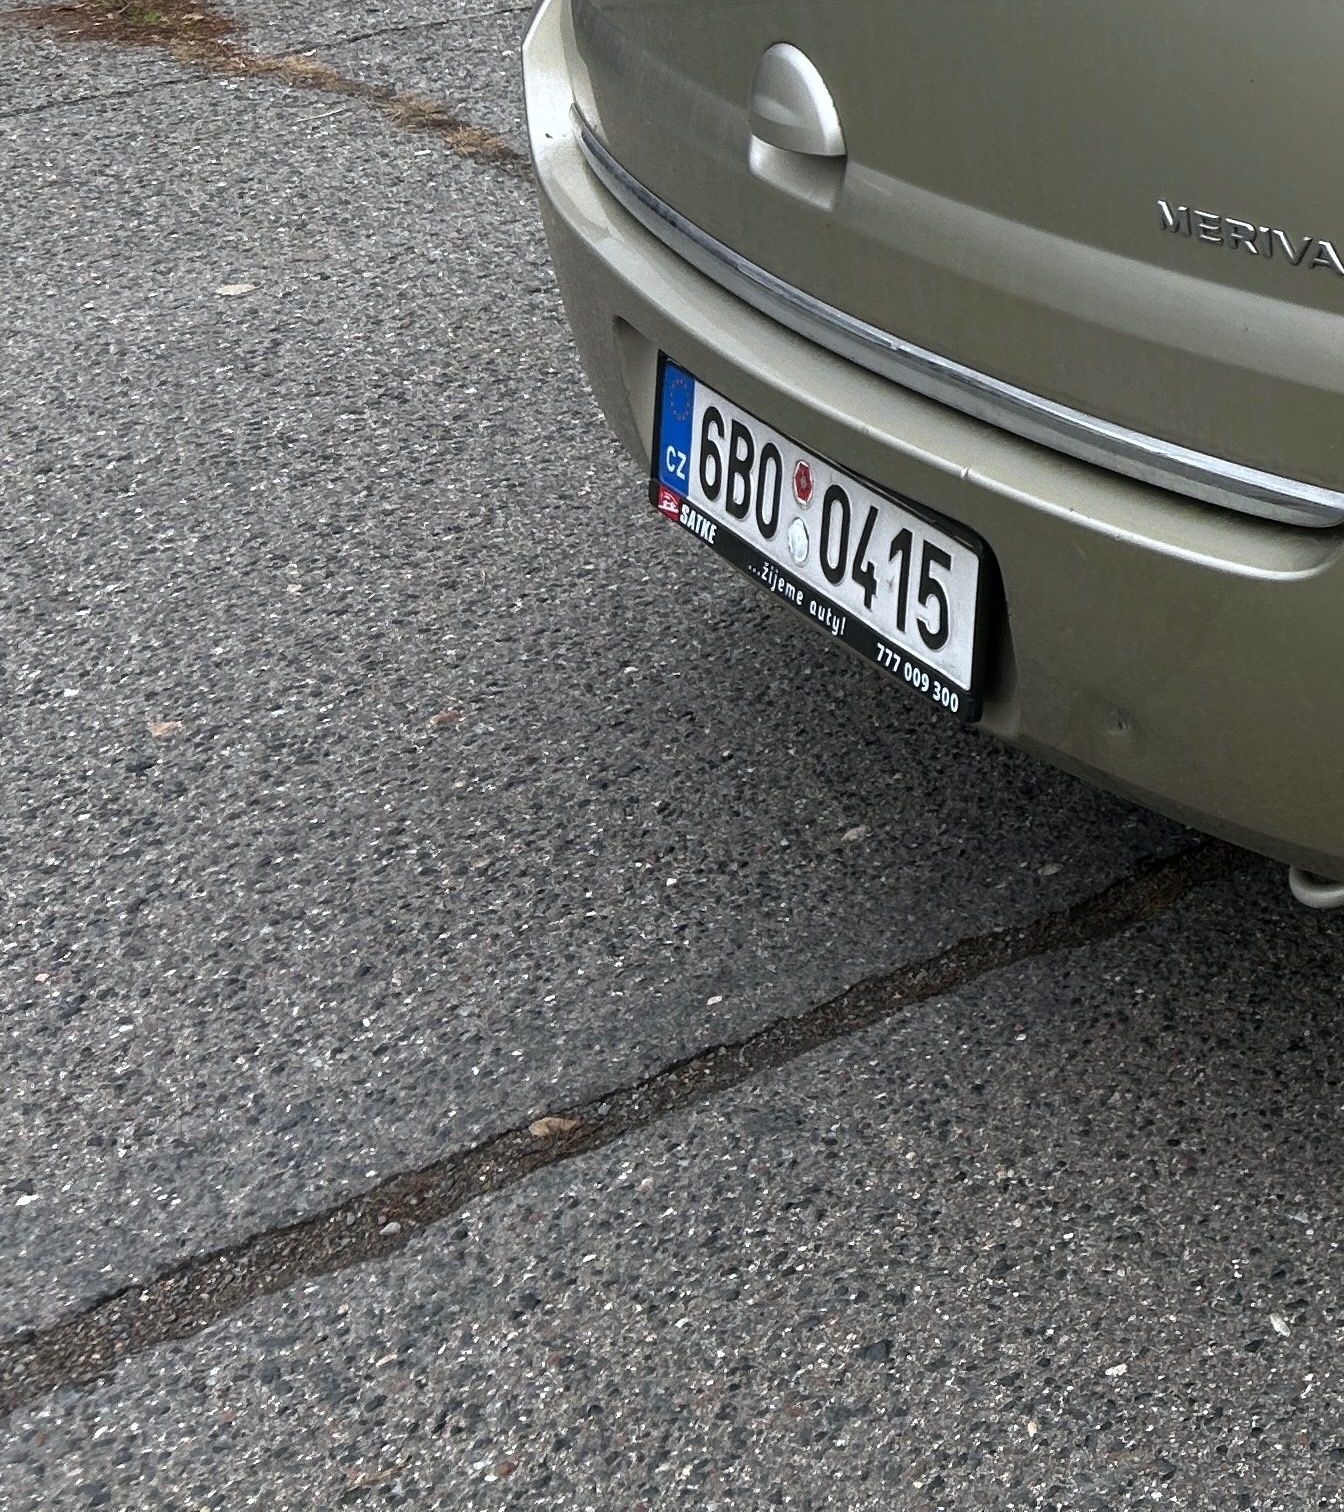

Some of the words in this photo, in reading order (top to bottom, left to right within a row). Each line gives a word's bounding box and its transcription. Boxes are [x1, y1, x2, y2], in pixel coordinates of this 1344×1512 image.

[666, 445, 687, 479] CZ
[819, 485, 952, 650] 0415
[876, 643, 901, 673] 777
[904, 665, 929, 692] 009
[933, 683, 959, 713] 300
